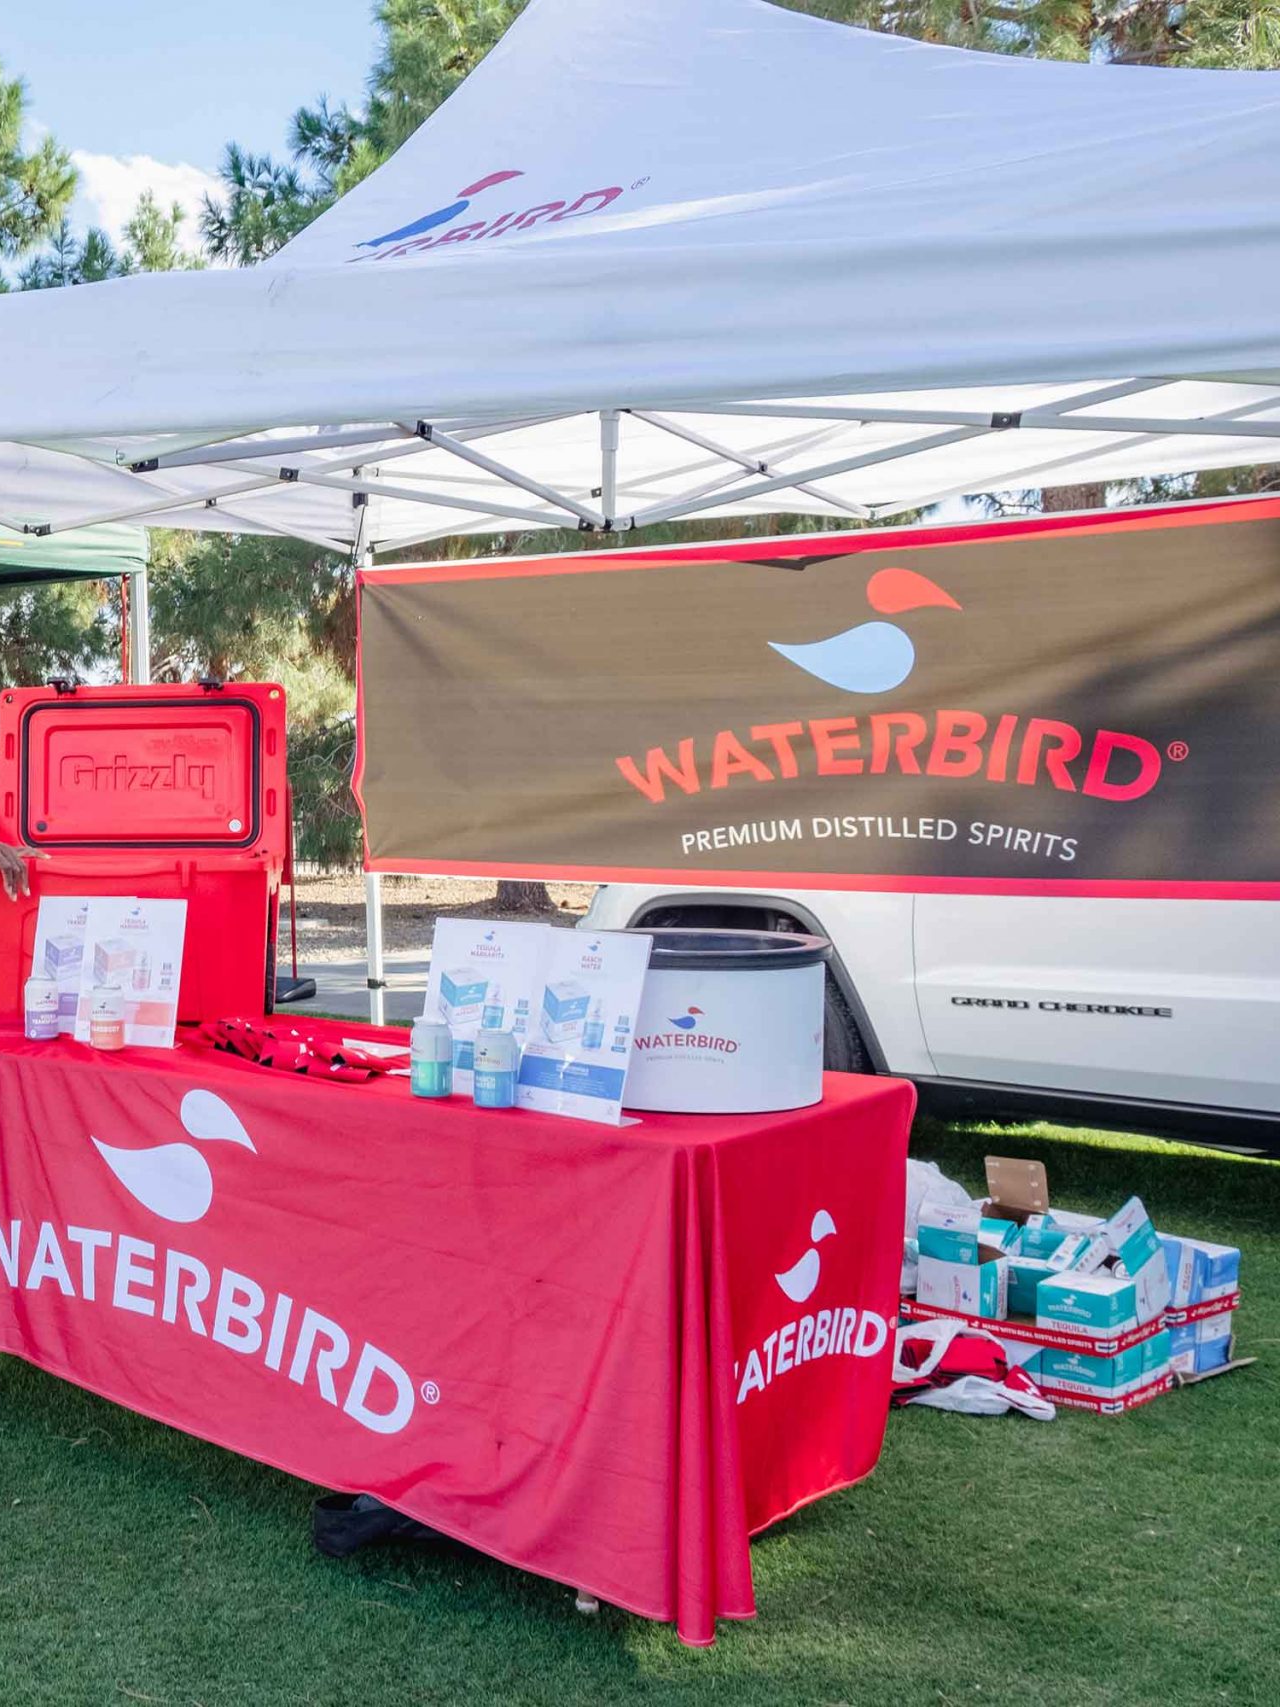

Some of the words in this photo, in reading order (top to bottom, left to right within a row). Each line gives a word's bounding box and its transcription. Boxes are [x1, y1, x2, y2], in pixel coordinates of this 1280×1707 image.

[59, 754, 215, 800] Grizzly
[681, 817, 802, 855] PREMIUM
[813, 814, 958, 842] DISTILLED
[969, 821, 1078, 863] SPIRITS
[950, 996, 1030, 1010] GRAND
[1038, 1001, 1173, 1018] CHEROKEE
[635, 1033, 739, 1054] WATERBIRD
[1051, 1320, 1089, 1334] TEQUILA
[733, 1307, 888, 1405] ATERBIRD
[1057, 1380, 1094, 1394] TEQUILA
